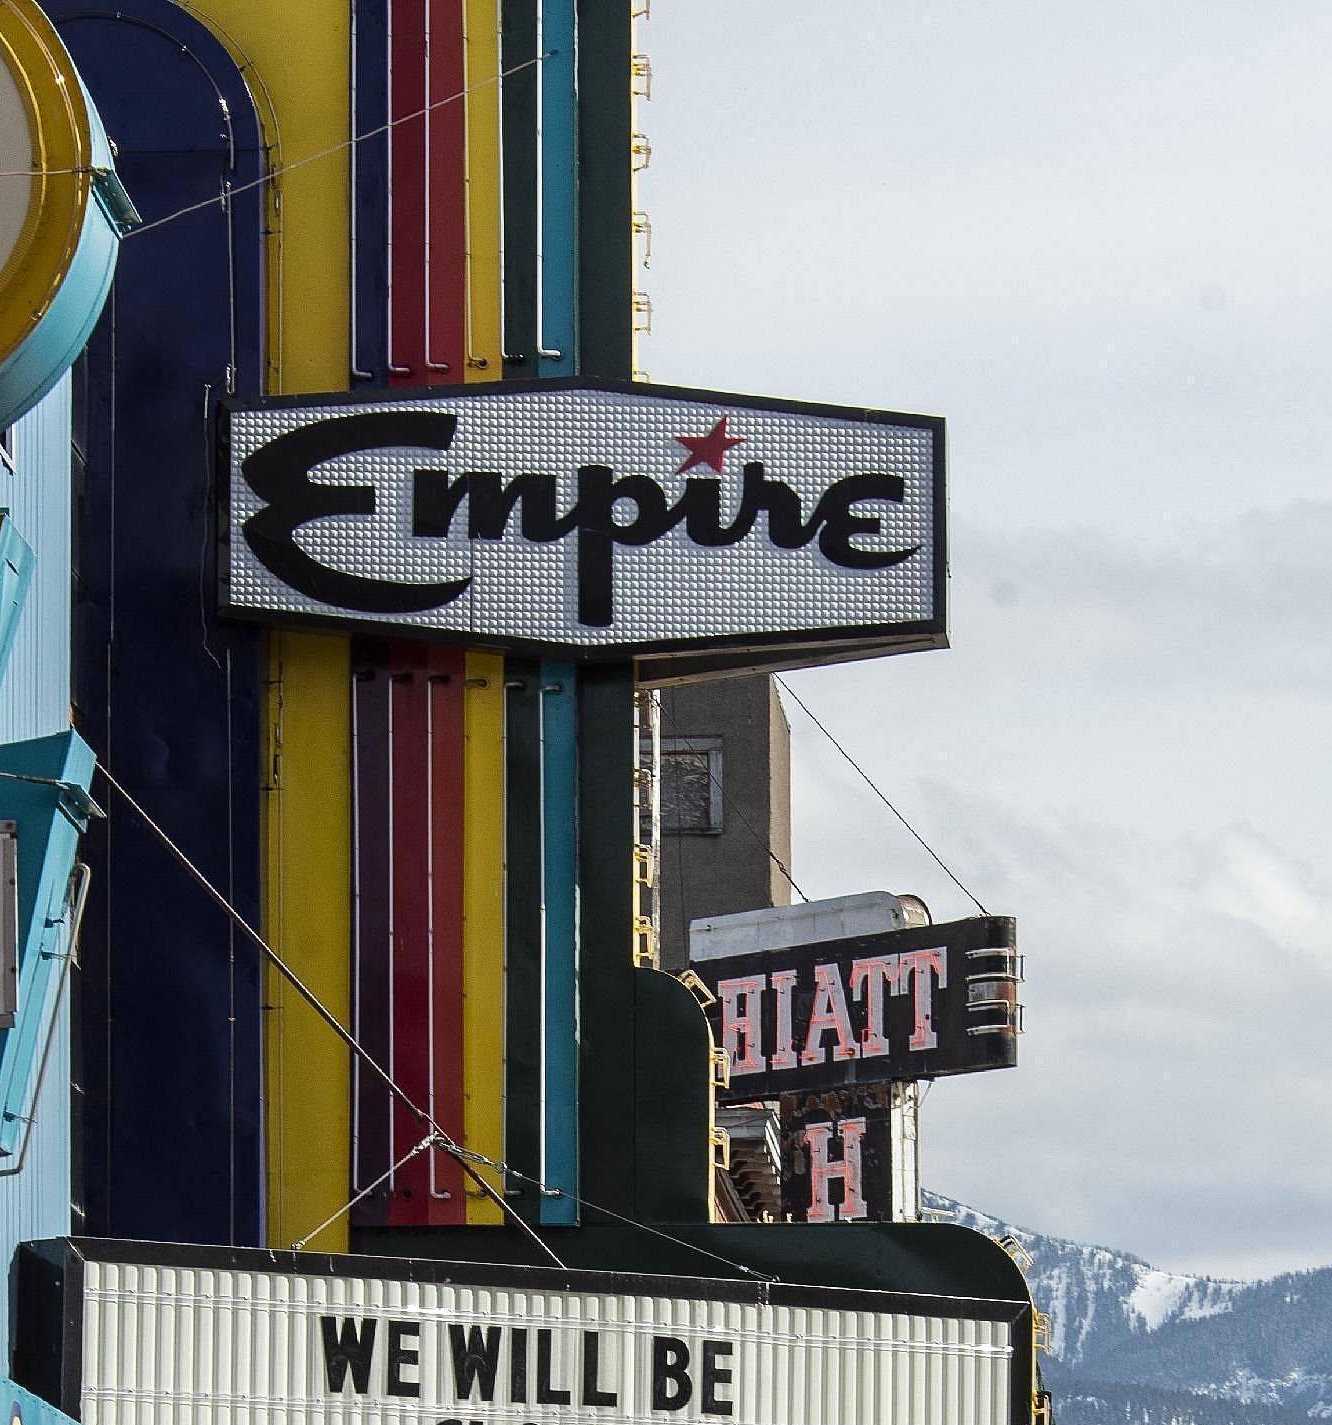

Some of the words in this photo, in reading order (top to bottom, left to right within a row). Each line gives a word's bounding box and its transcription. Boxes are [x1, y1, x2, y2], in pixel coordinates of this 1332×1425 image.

[240, 410, 921, 627] Empire
[717, 946, 948, 1077] HIATT
[320, 1316, 420, 1398] WE
[449, 1323, 617, 1407] WILL
[652, 1336, 734, 1416] BE
